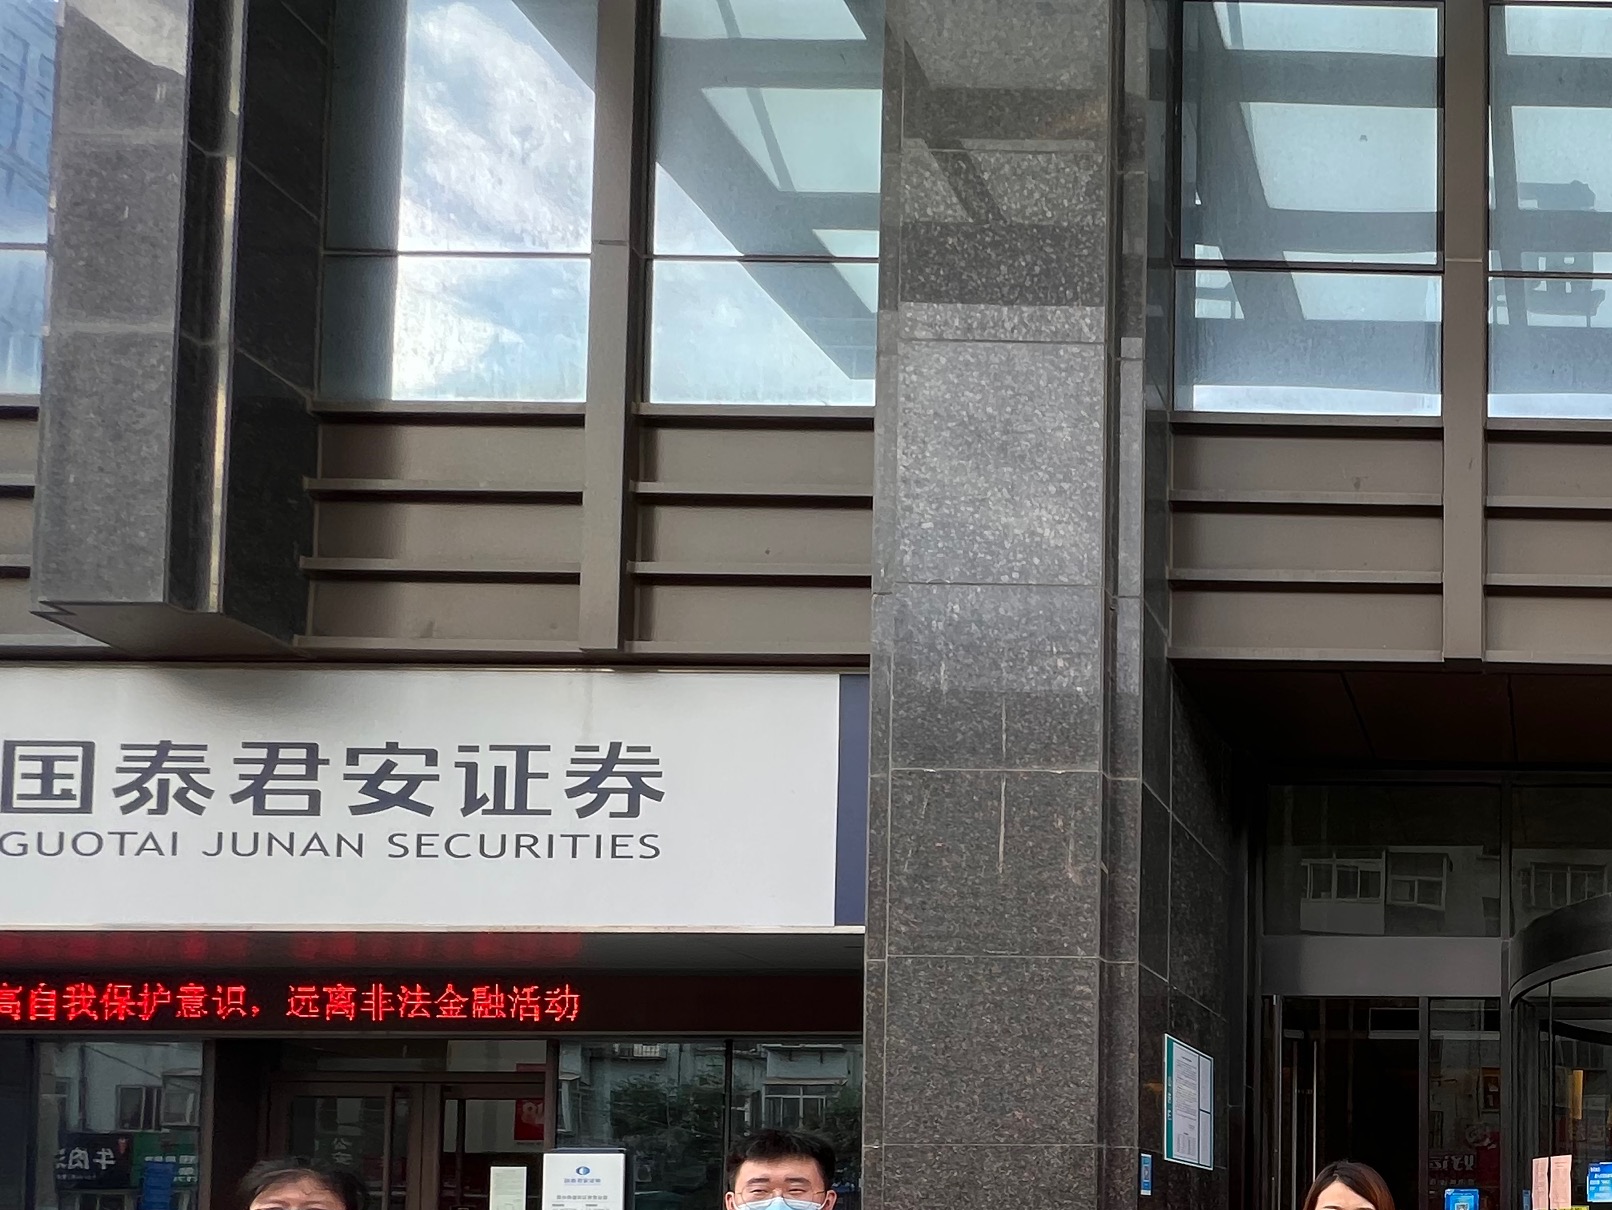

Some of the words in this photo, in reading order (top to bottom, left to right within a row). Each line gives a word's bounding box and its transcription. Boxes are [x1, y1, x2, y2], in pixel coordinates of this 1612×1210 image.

[2, 739, 666, 820] 国泰君安证券
[0, 830, 178, 858] GUOTAI
[201, 831, 365, 859] JUNAN
[387, 832, 662, 860] SECURITIES
